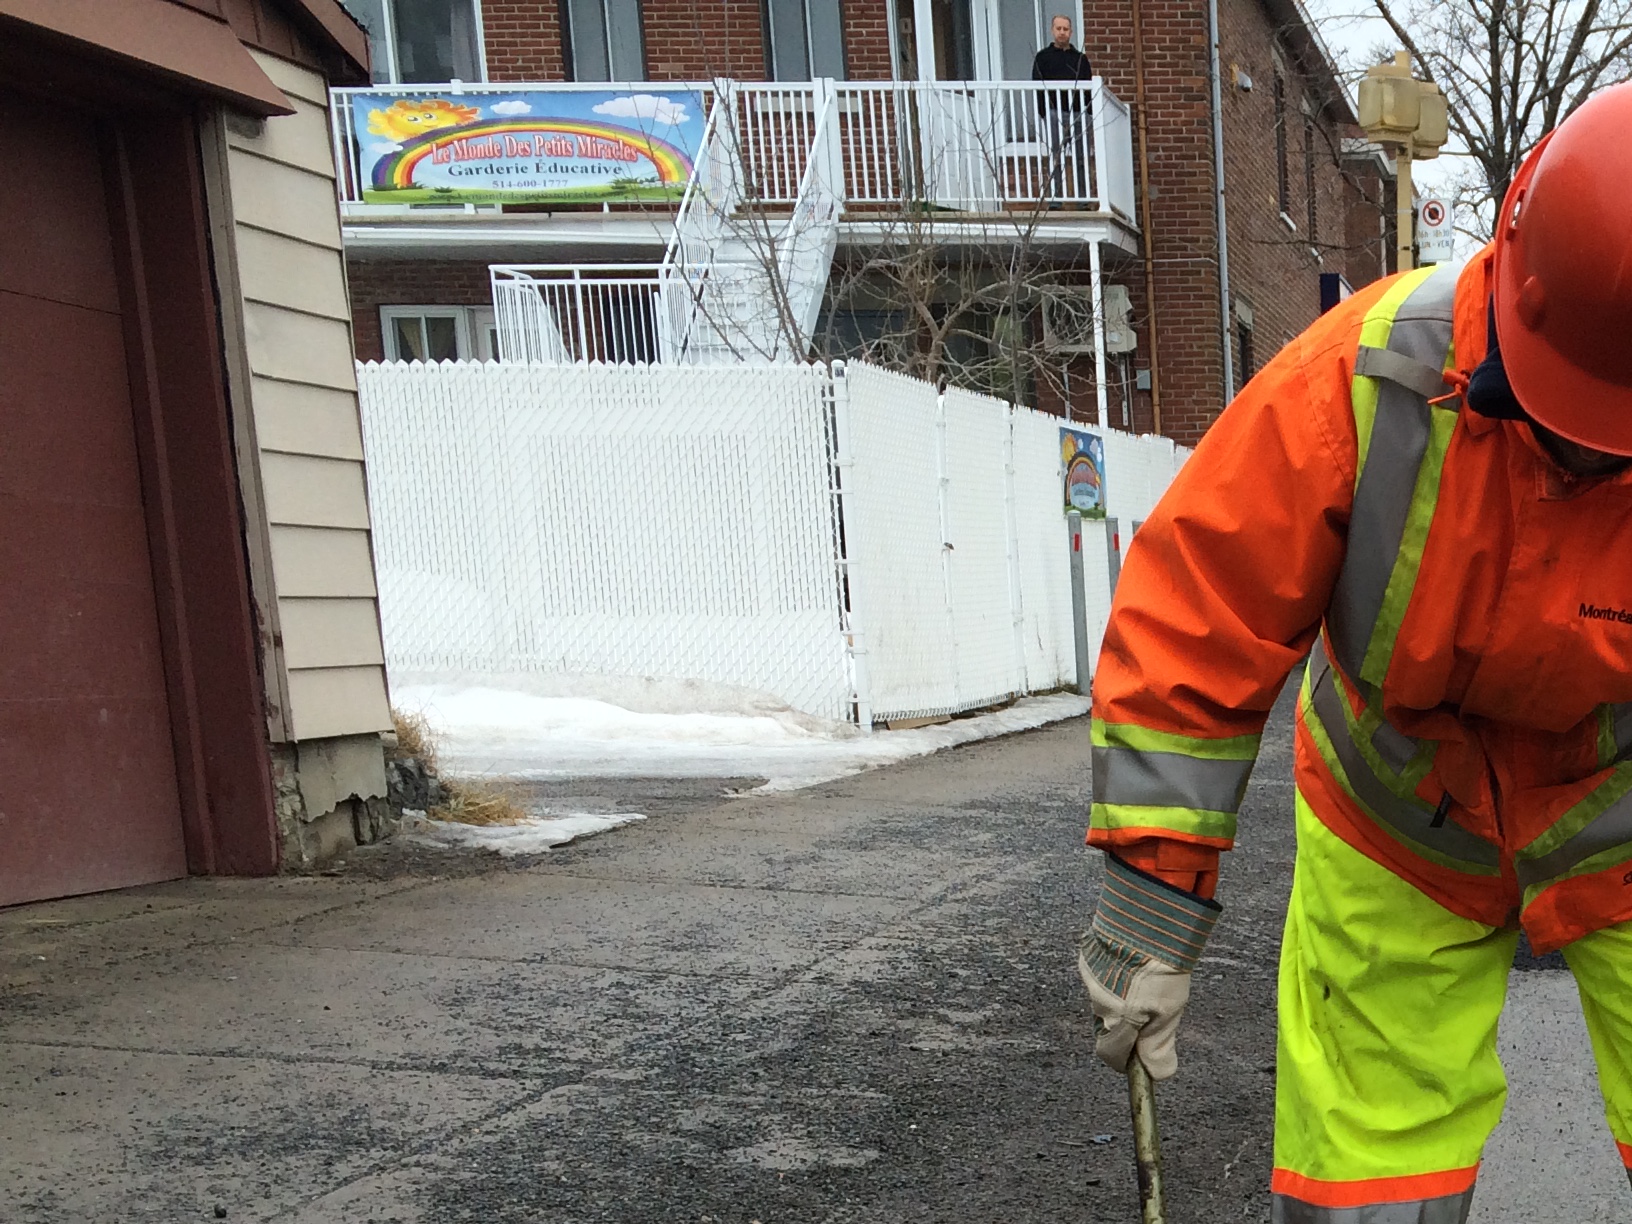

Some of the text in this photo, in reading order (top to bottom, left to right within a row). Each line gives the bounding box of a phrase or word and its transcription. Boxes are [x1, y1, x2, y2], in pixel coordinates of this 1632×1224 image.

[432, 134, 638, 165] Le Monde Des Petits Miracles
[448, 158, 622, 177] Garderie Éducative
[491, 180, 569, 189] 514-600-1777
